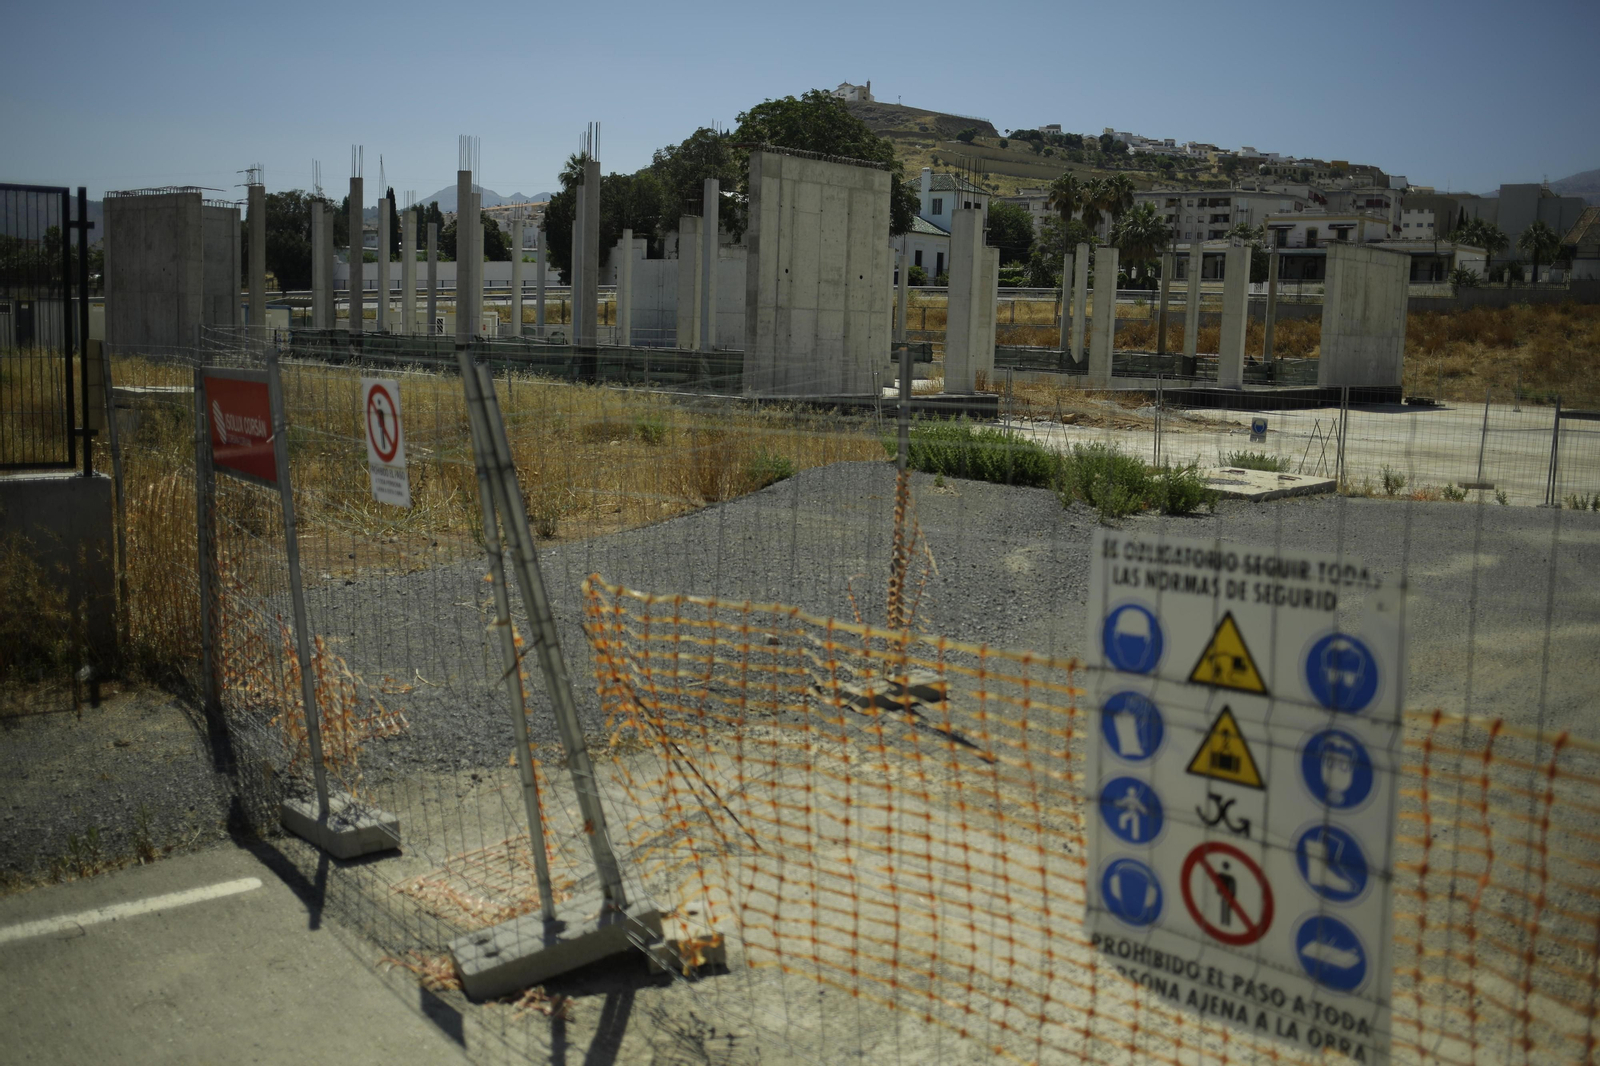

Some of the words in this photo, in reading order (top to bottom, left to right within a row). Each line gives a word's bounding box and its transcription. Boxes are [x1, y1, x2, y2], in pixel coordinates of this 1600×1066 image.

[1112, 565, 1140, 588] LAS
[1145, 569, 1219, 599] NORMAS
[1226, 580, 1246, 602] DE
[1244, 553, 1311, 581] SEGUIR
[1091, 932, 1200, 980] PROHIBIDO
[1206, 966, 1226, 990] EL
[1233, 974, 1286, 1008] PASO
[1292, 995, 1306, 1016] A
[1313, 1001, 1370, 1038] TODA
[1186, 988, 1249, 1024] AJENA
[1255, 1011, 1269, 1032] A
[1275, 1016, 1299, 1042] LA
